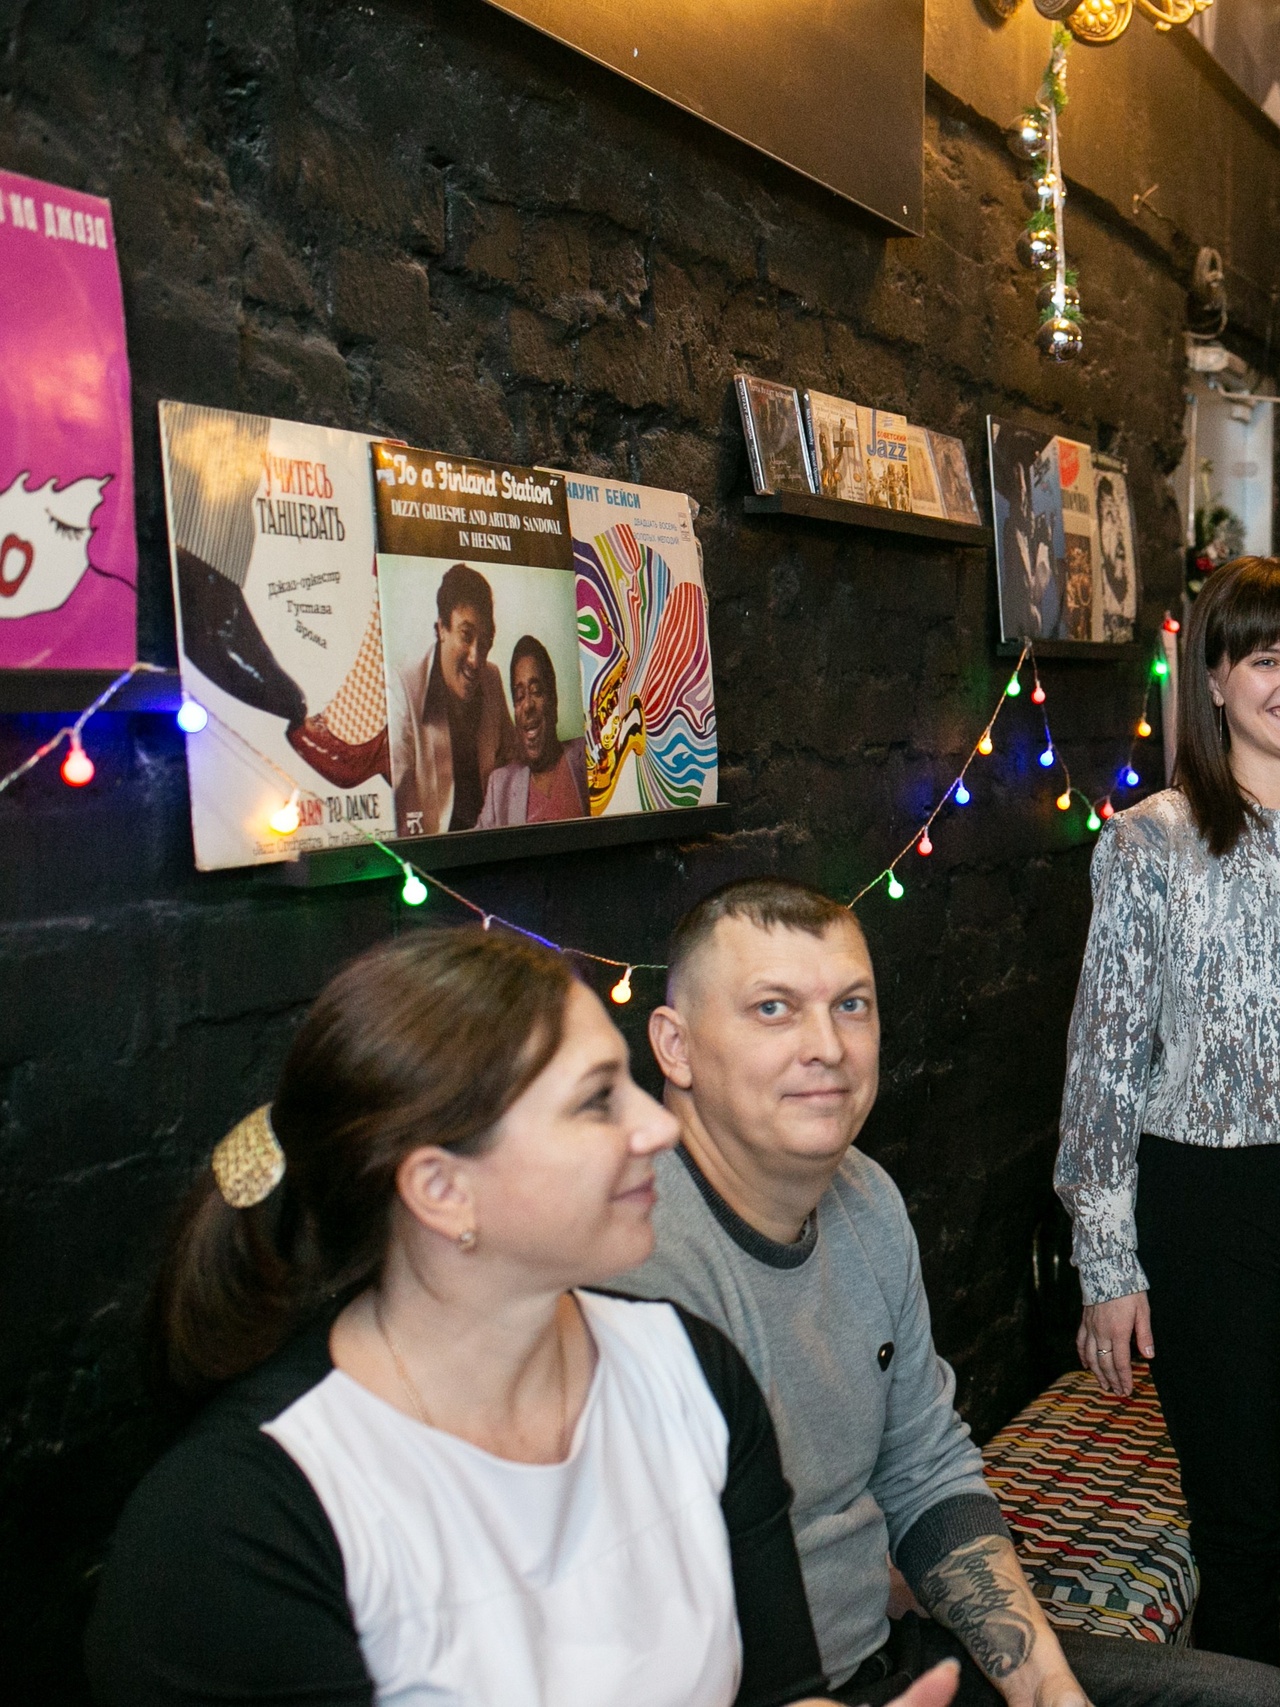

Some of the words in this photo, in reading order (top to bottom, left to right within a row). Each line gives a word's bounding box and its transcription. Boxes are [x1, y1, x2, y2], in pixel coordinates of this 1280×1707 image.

[867, 409, 908, 461] Jazz
[877, 431, 907, 442] СОВЕТСКИЙ
[261, 452, 334, 499] УЧИТЕСЬ
[421, 467, 435, 489] a
[435, 460, 498, 498] Finland
[605, 487, 641, 509] БЕЙСИ
[257, 498, 345, 543] ТАНЦЕВАТЬ
[391, 499, 420, 518] DIZZY
[422, 503, 467, 524] GILLESPIE
[469, 509, 487, 526] AND
[488, 512, 521, 531] ARTURO
[522, 516, 562, 535] SANDOVAL
[459, 530, 470, 547] IN
[471, 532, 512, 551] HELSINKI
[267, 571, 341, 600] Джаз-оркестр
[287, 600, 333, 617] Густава
[295, 619, 328, 649] Брома
[327, 796, 343, 823] TO
[346, 793, 380, 822] DANCE
